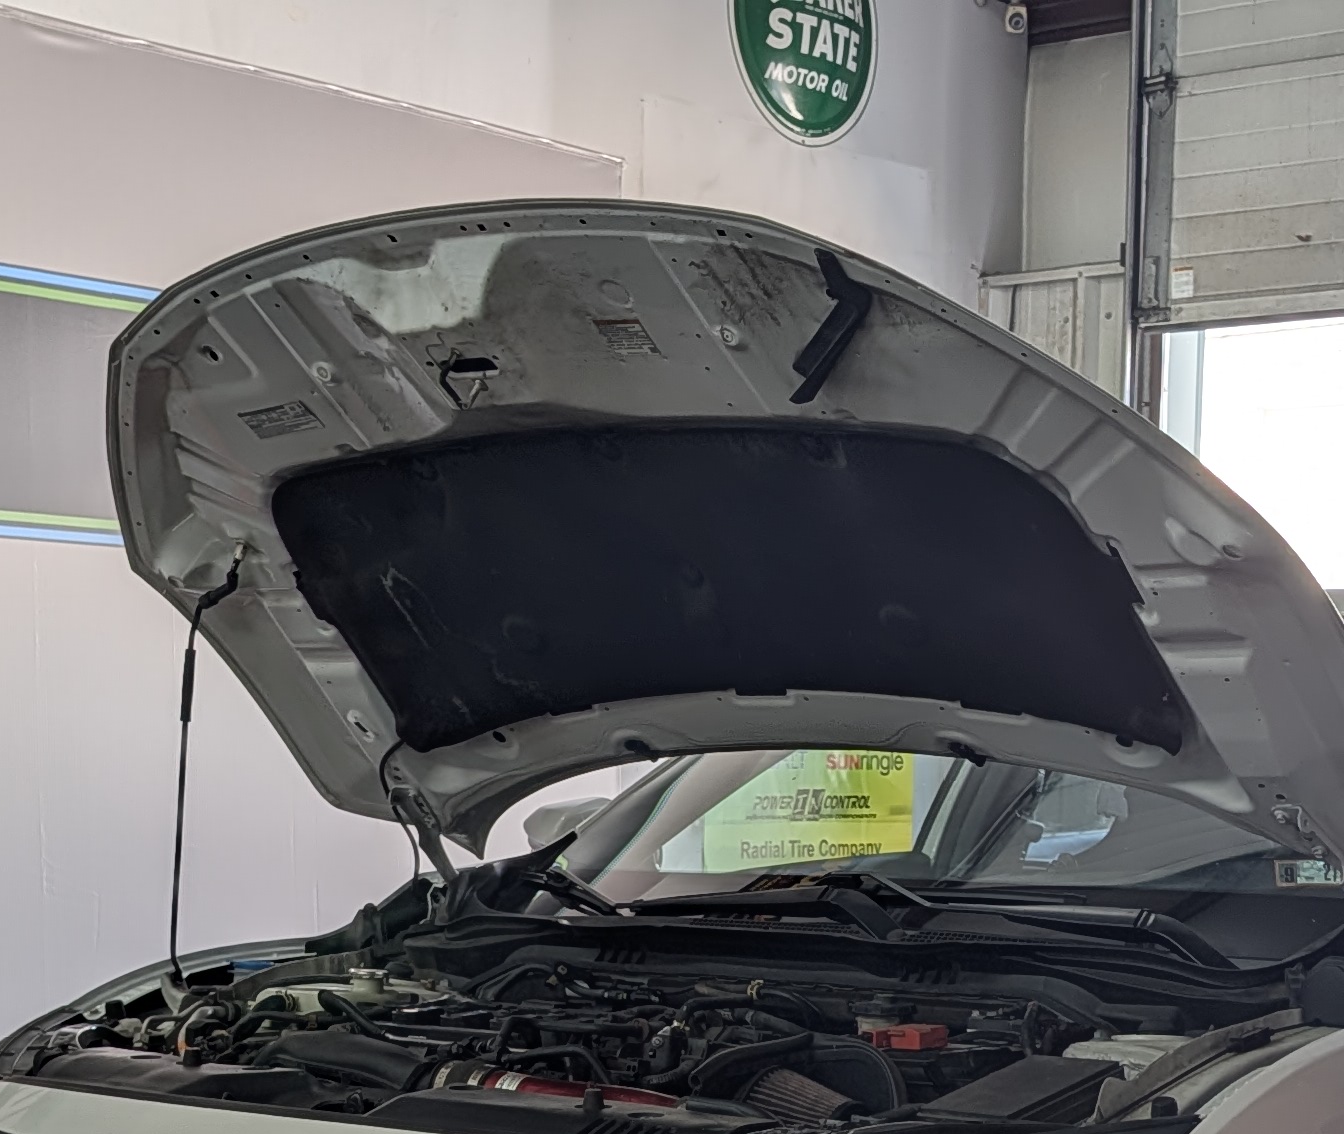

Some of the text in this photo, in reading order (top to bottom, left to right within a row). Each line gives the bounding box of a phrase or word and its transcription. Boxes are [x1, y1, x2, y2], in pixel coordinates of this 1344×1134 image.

[766, 8, 860, 73] STATE
[764, 61, 849, 102] MOTOR OIL
[753, 795, 794, 811] POWER
[823, 795, 871, 810] CONTROL
[741, 839, 883, 860] Radial Tire Company
